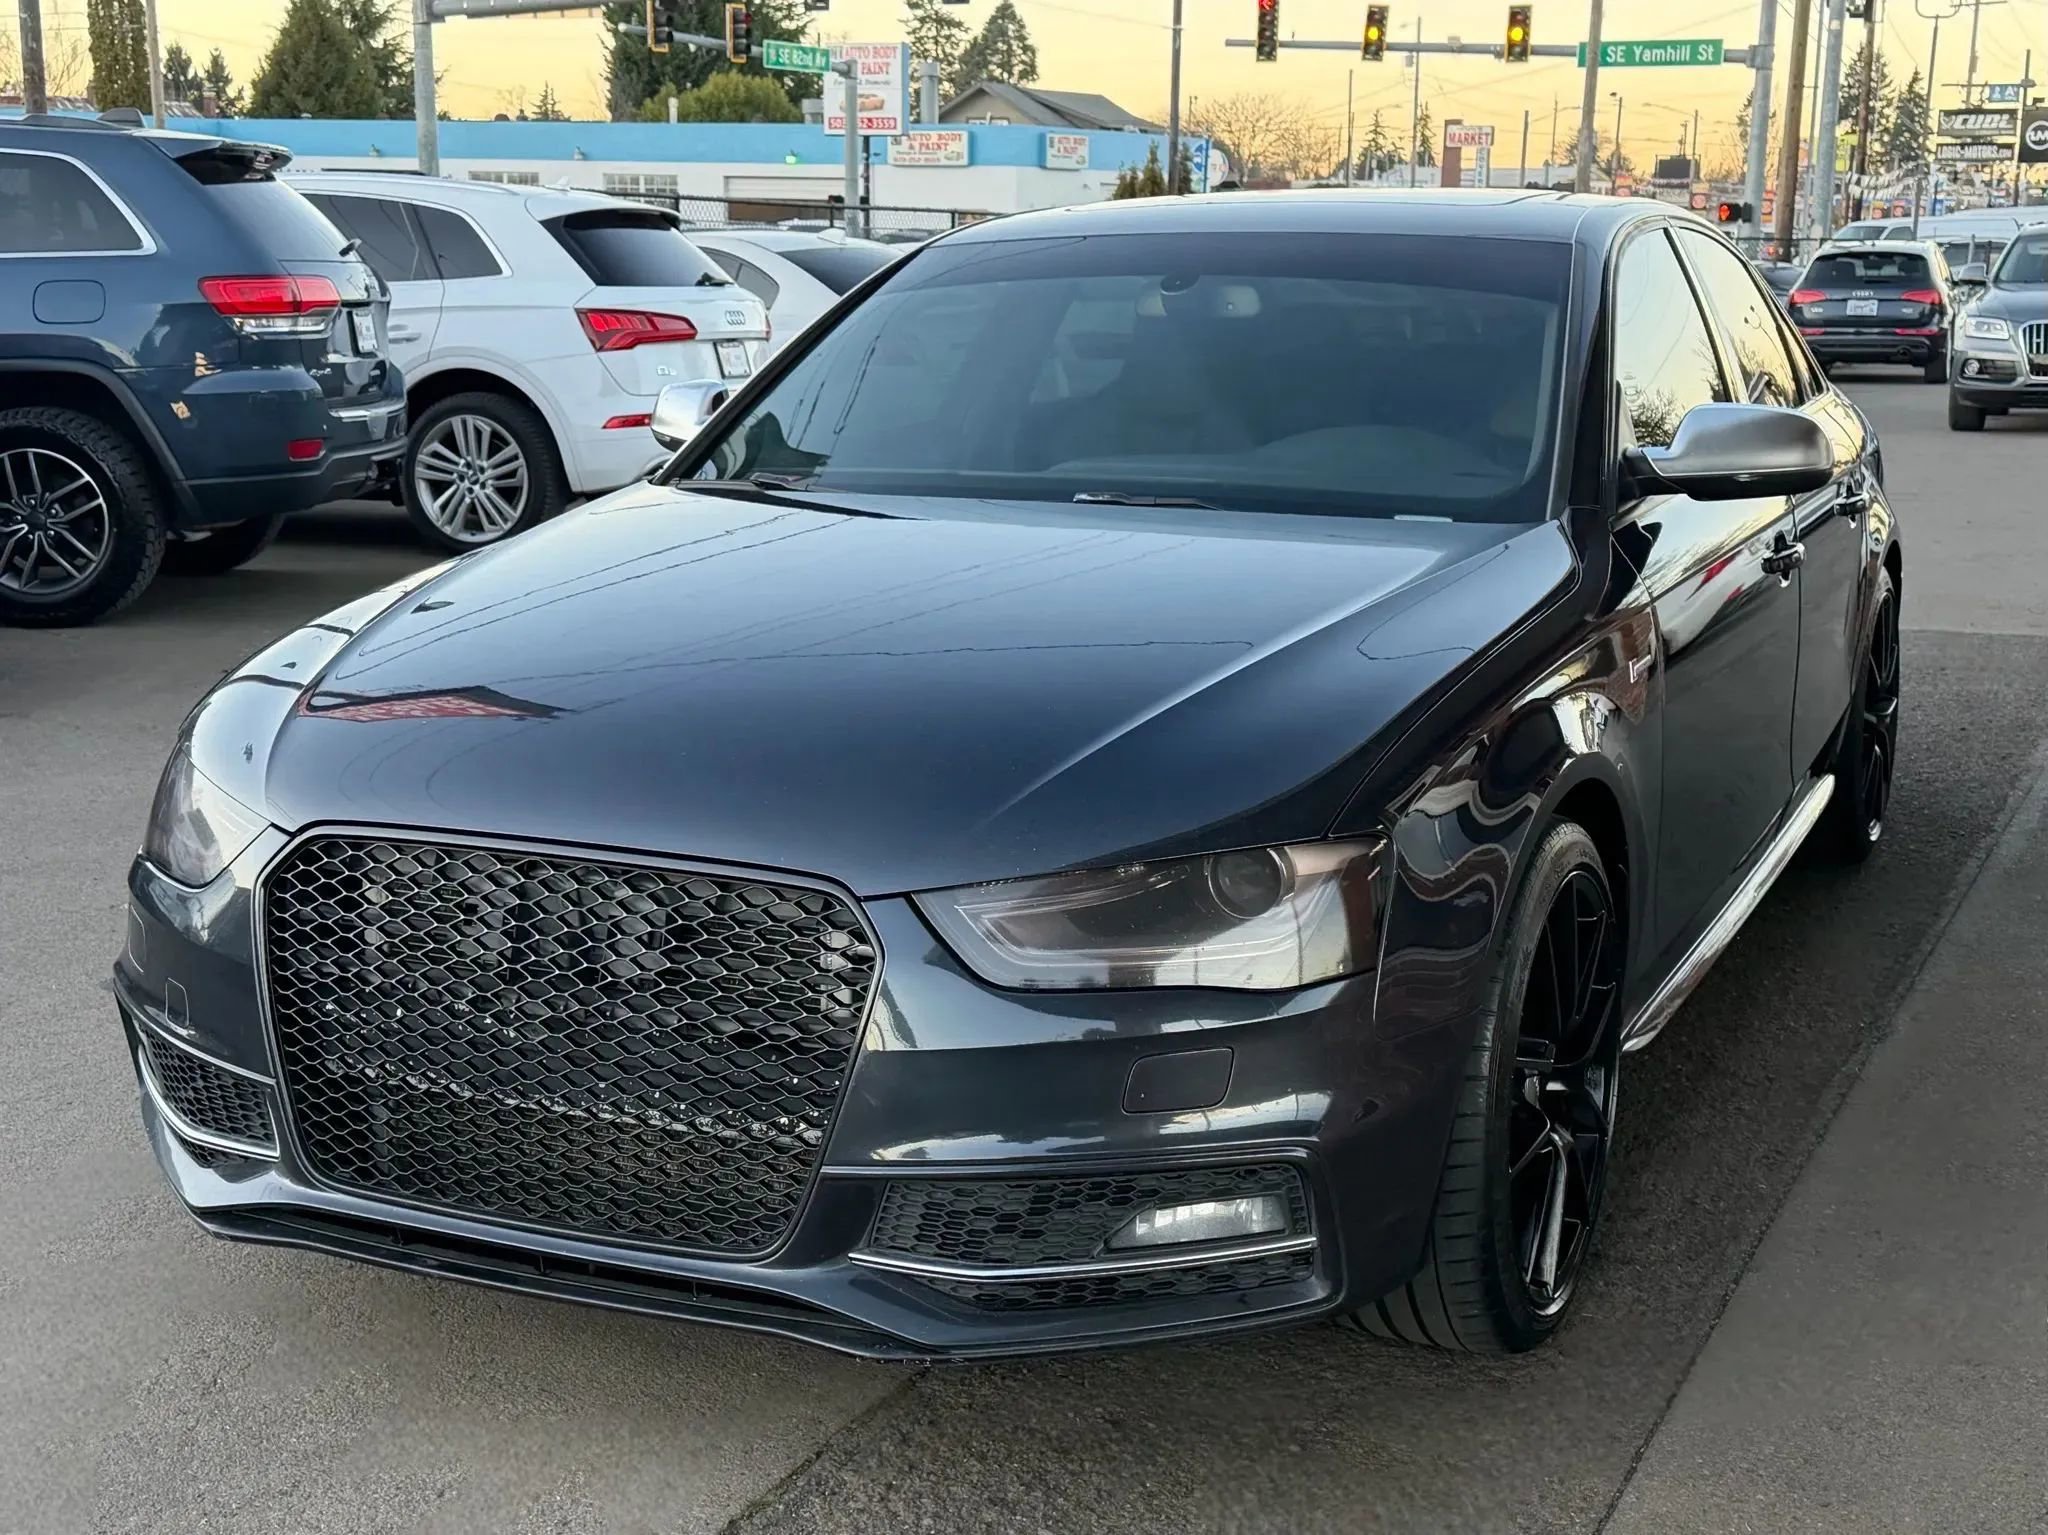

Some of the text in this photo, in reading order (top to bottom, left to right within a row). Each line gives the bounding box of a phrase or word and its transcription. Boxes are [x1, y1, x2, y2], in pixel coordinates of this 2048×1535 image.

[779, 47, 790, 63] SE
[792, 49, 814, 66] 82nd
[845, 46, 870, 59] AUTO
[872, 46, 898, 59] BODY
[1606, 44, 1715, 63] SE Yamhill St
[861, 62, 891, 75] PAINT
[905, 132, 931, 142] AUTO
[1448, 132, 1490, 146] MARKET
[918, 142, 950, 151] PAINT
